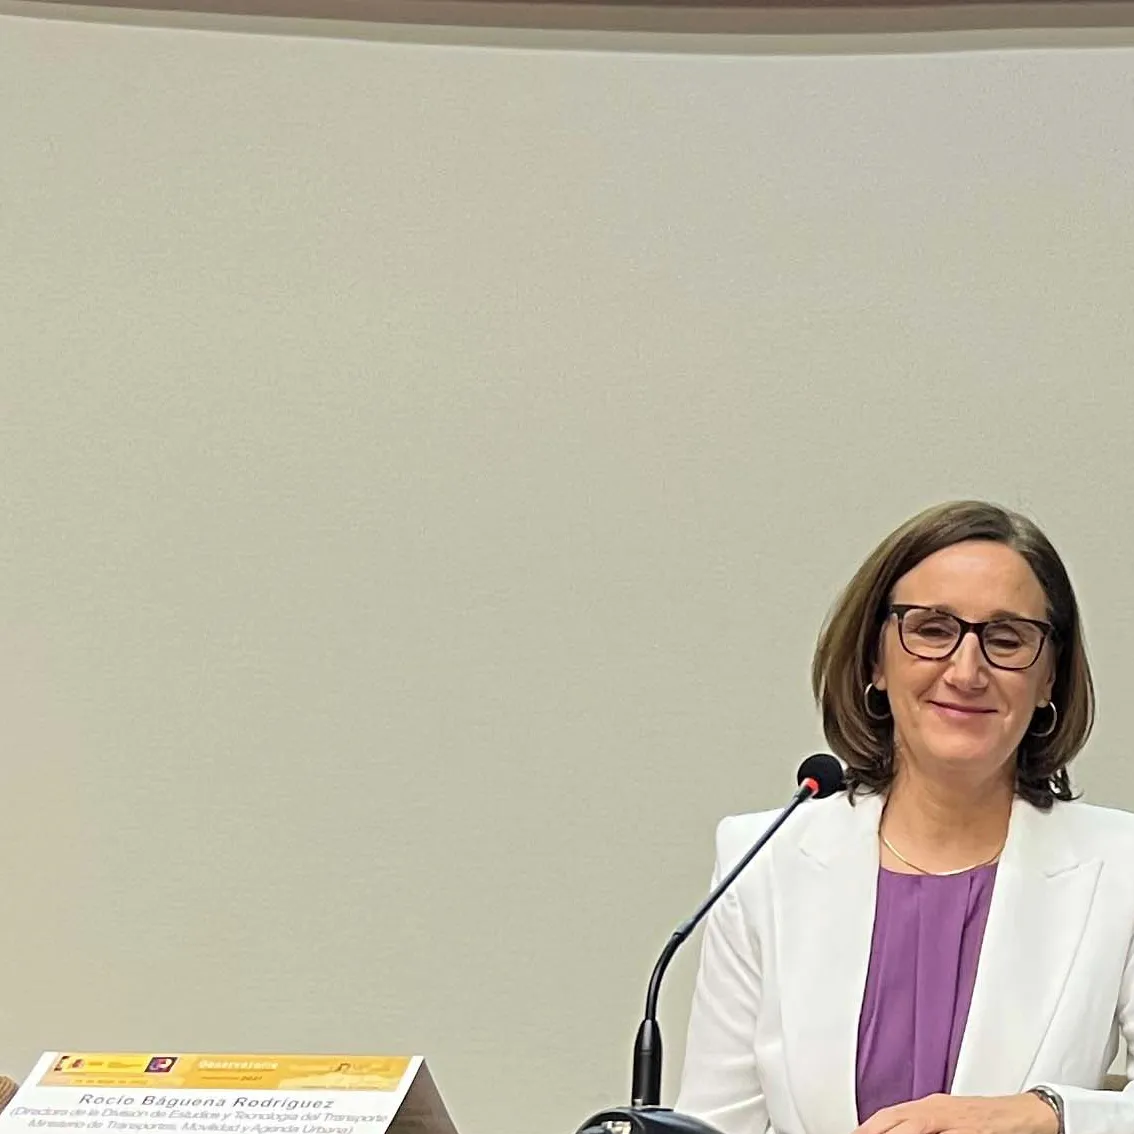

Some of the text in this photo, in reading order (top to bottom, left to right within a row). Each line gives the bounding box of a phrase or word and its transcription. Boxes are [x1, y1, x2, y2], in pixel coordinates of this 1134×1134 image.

[79, 1094, 335, 1110] Rocío Báguena Rodríguez
